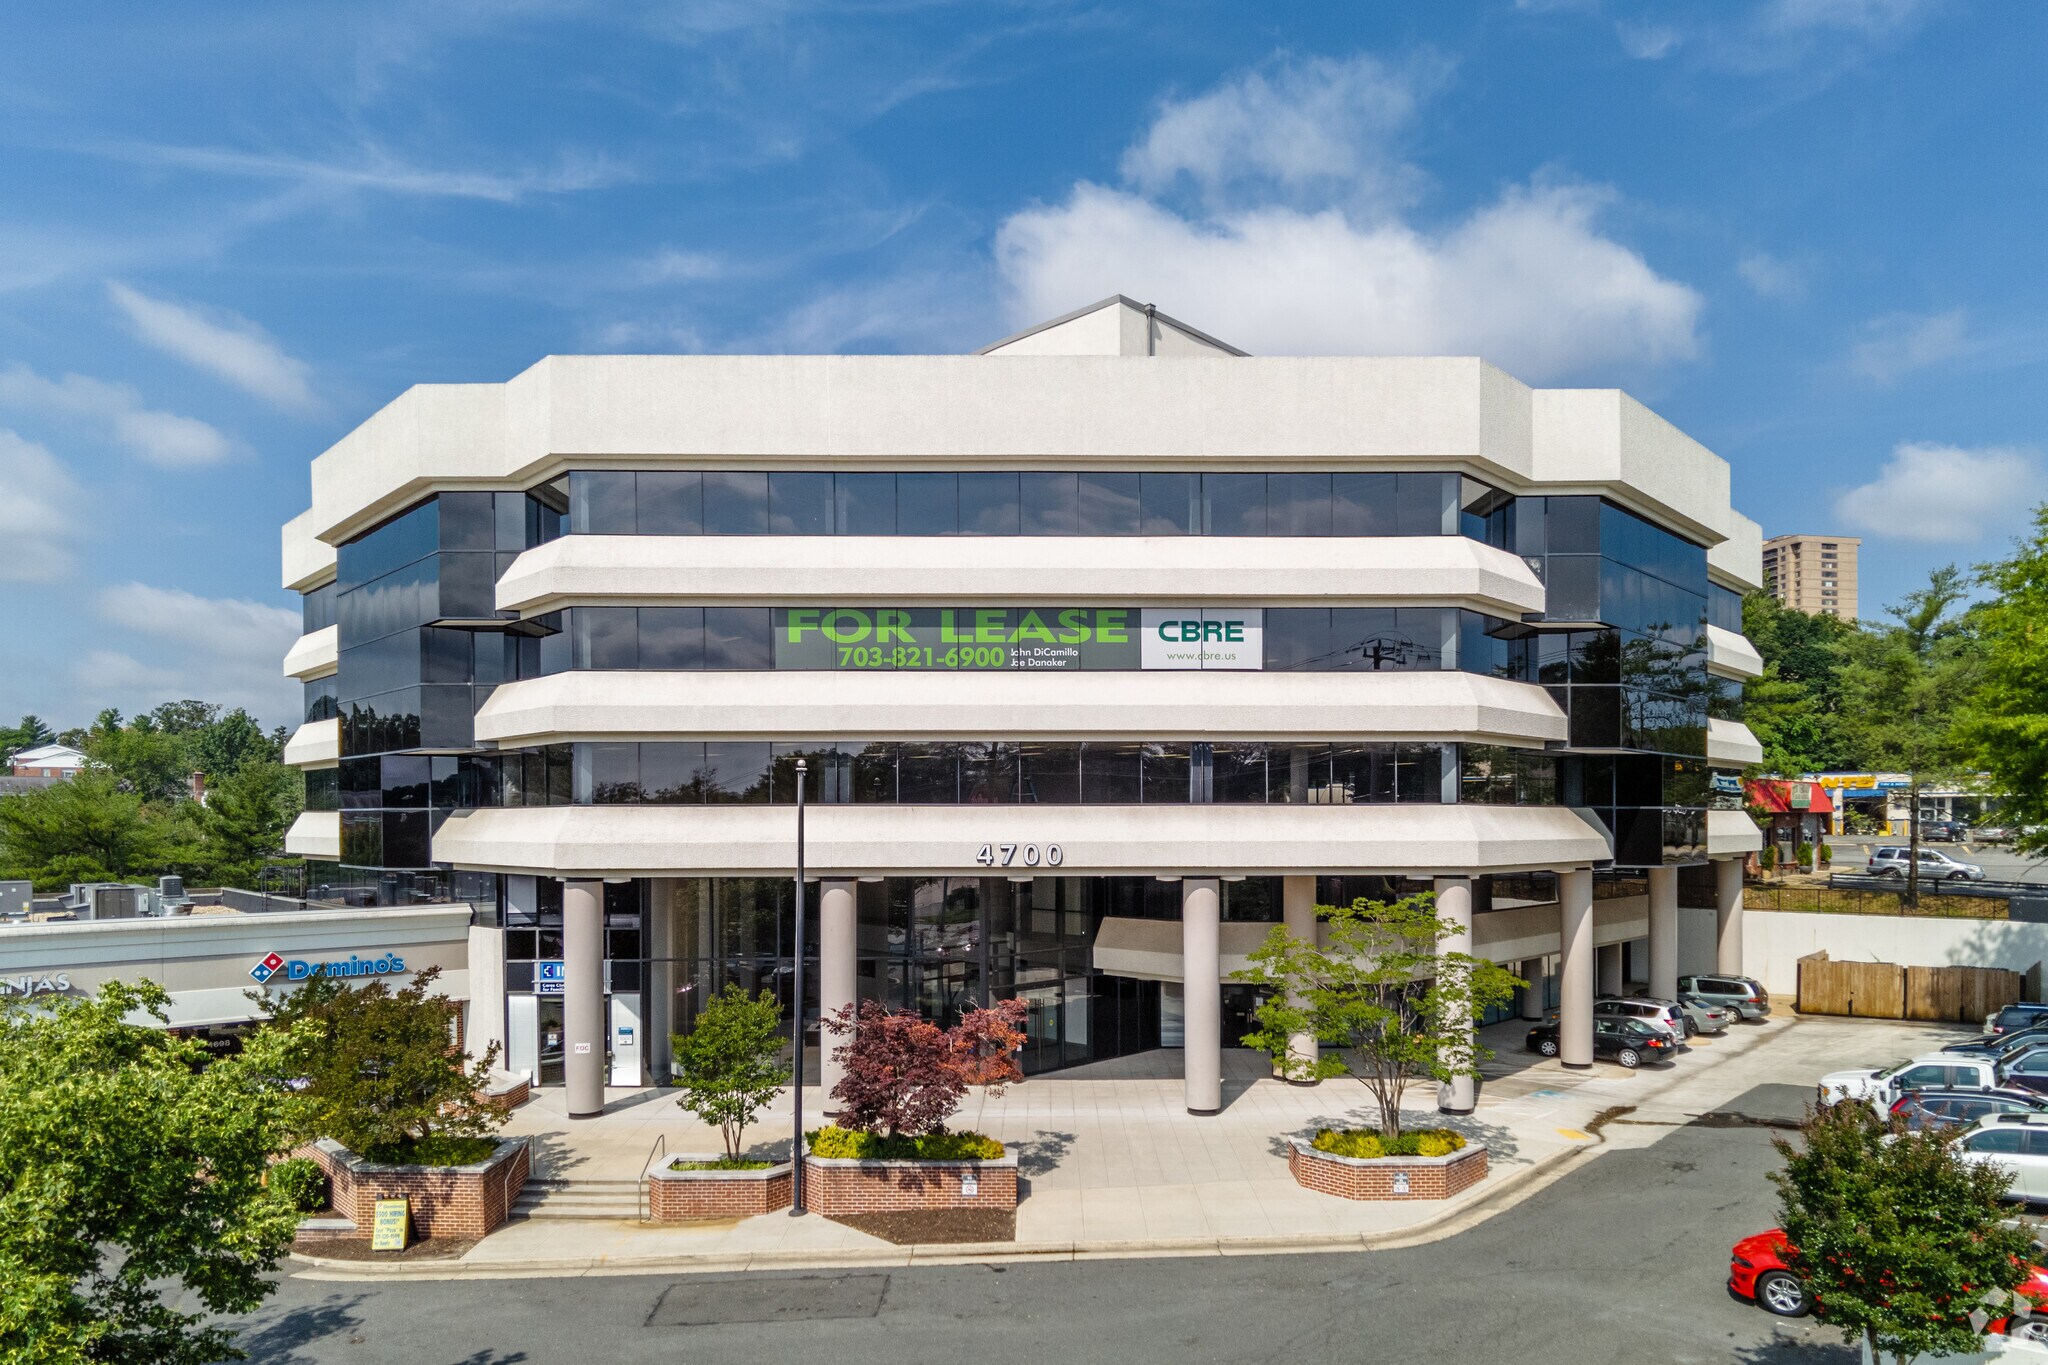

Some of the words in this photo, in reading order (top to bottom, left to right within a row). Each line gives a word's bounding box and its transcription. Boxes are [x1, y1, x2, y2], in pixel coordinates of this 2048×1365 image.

[788, 609, 916, 644] FOR
[941, 609, 1129, 644] LEASE
[1158, 620, 1244, 642] CBRE
[838, 647, 1005, 667] 703-821-6900
[1010, 648, 1031, 656] John
[1034, 648, 1079, 656] DiCamillo
[1010, 658, 1025, 667] Joe
[1028, 658, 1067, 667] Danaker
[1167, 650, 1237, 661] www.cbre.us
[976, 843, 1063, 865] 4700
[288, 952, 406, 980] Domino's
